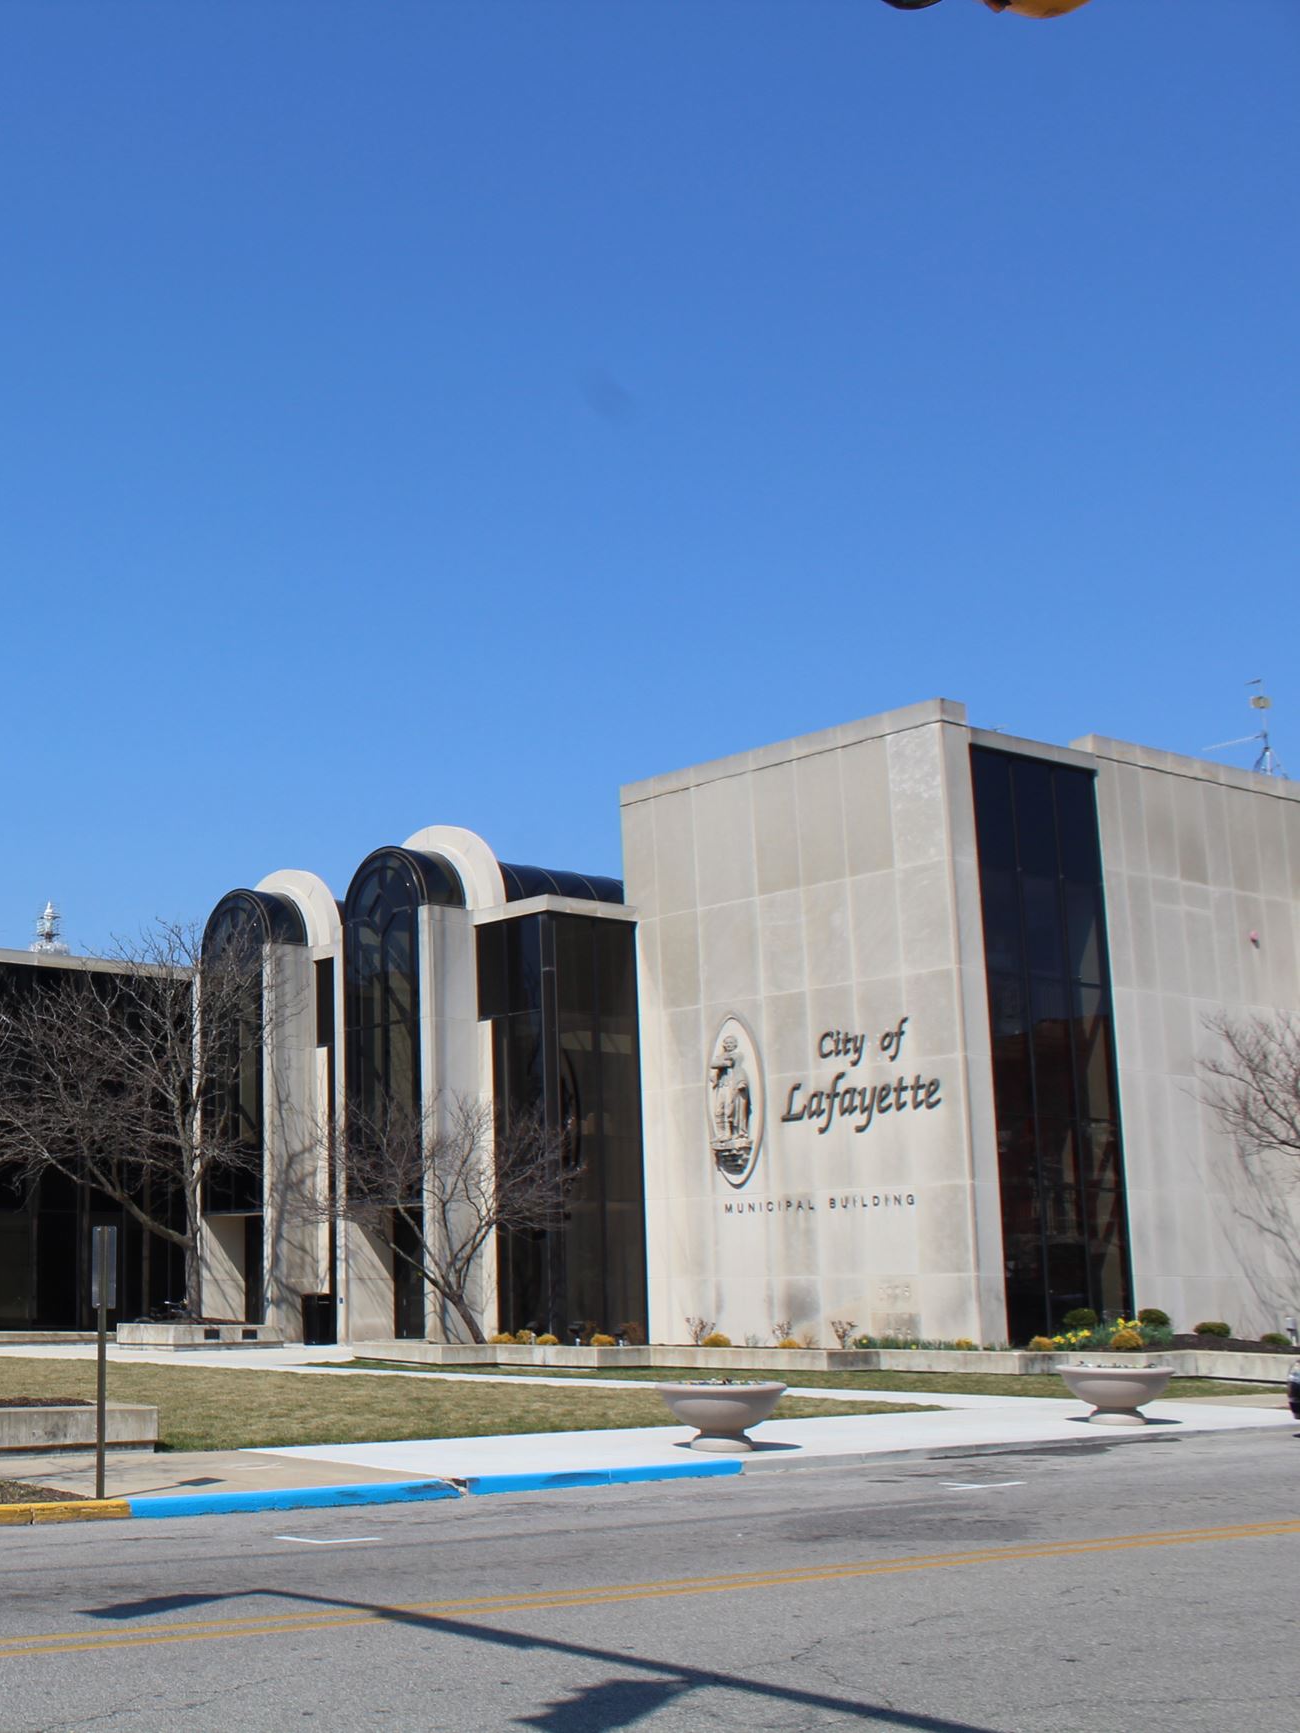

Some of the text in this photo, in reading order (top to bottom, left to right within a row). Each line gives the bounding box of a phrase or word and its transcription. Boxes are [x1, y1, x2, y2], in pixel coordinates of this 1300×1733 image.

[818, 1016, 908, 1066] City of
[781, 1072, 942, 1134] Lafayette
[724, 1194, 916, 1214] MUNICIPAL BUILDING
